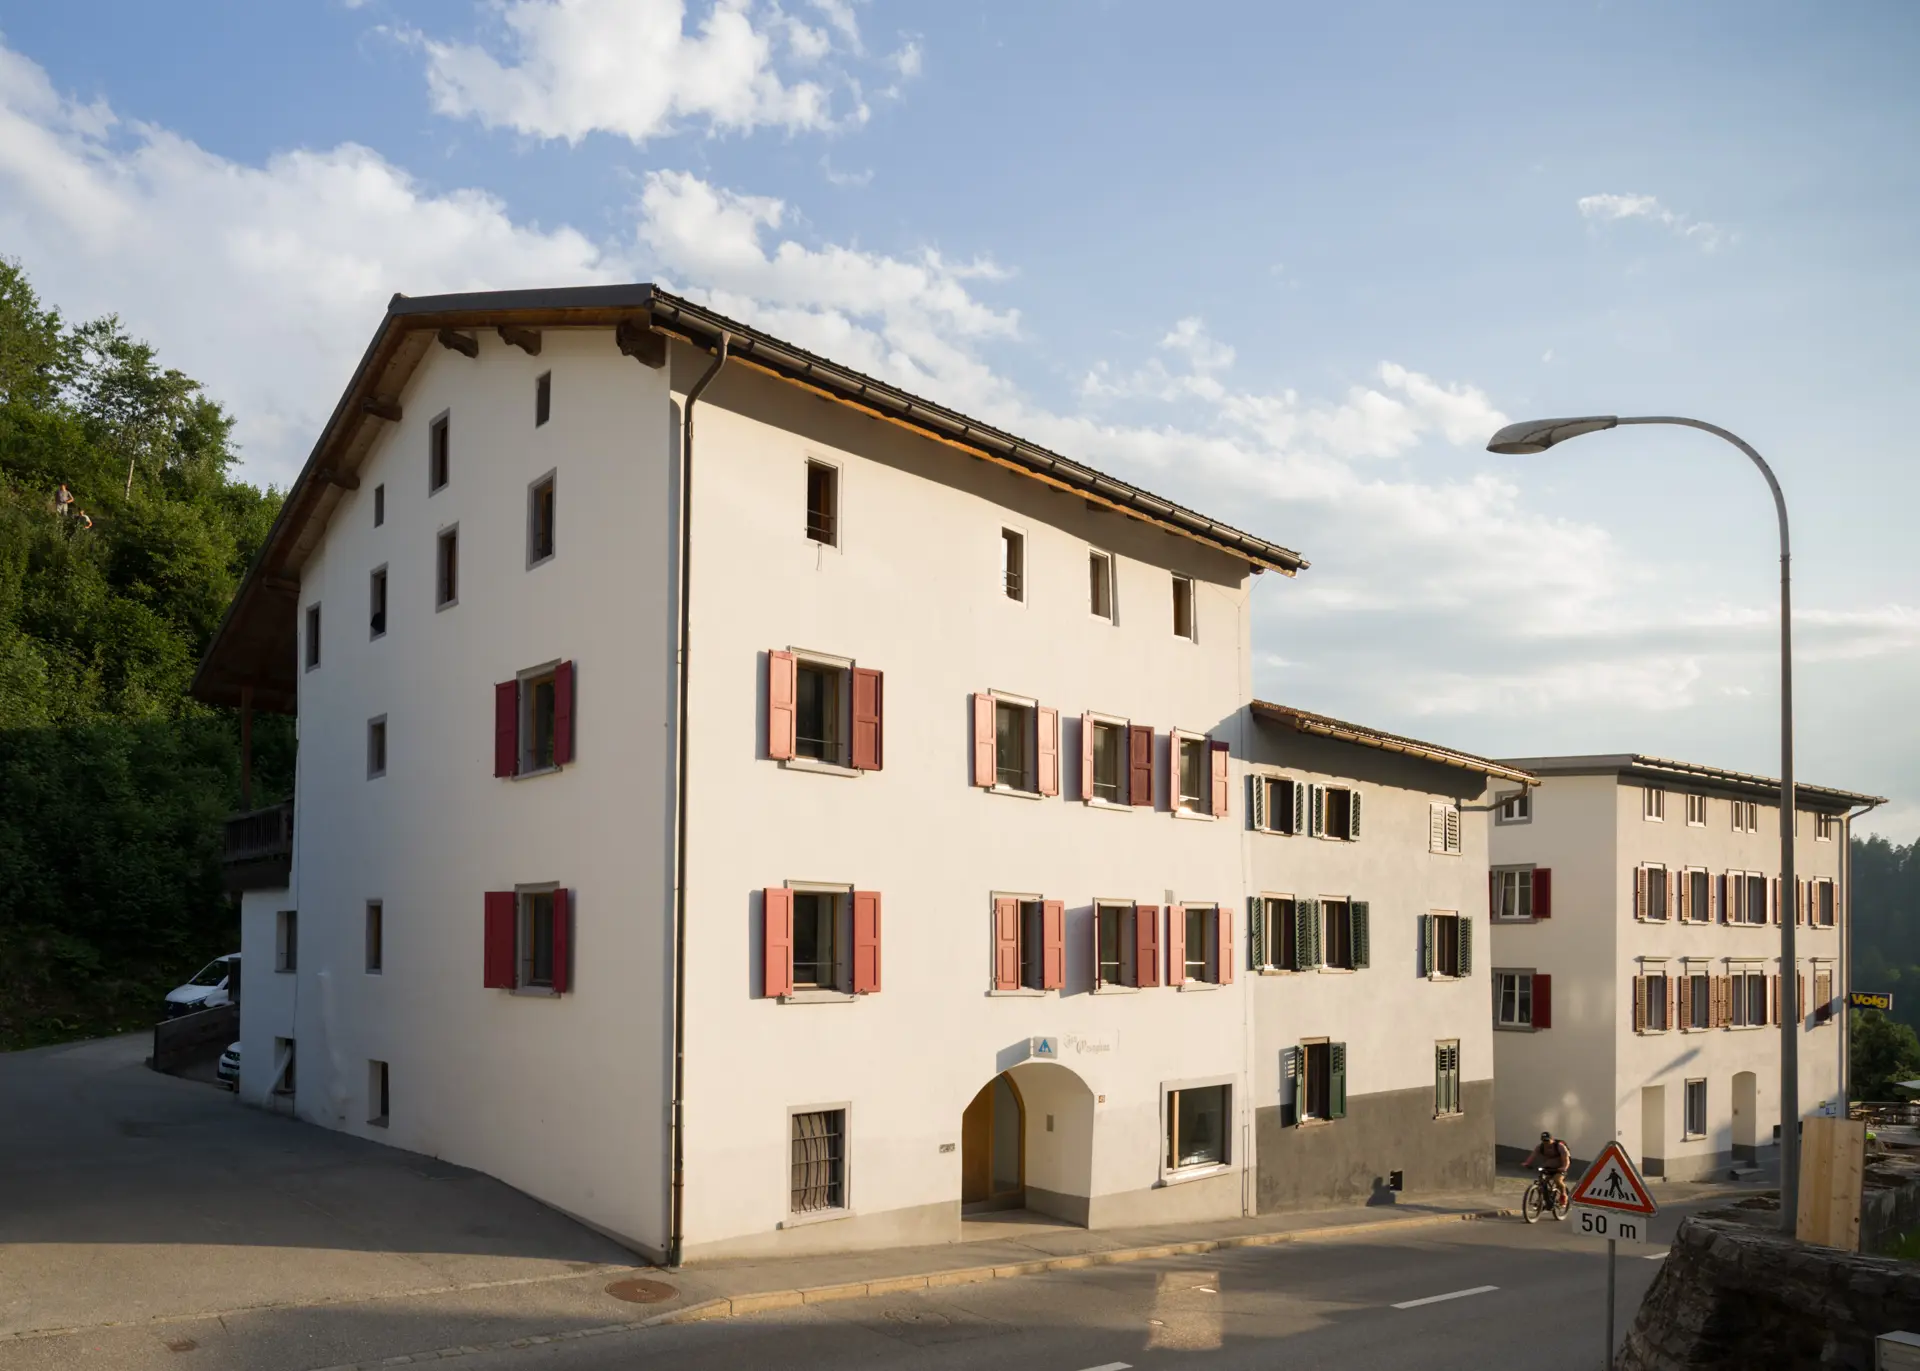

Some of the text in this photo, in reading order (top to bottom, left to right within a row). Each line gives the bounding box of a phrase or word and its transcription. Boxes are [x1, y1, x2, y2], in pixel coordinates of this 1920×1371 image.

[1852, 994, 1888, 1009] Volg
[1581, 1212, 1636, 1239] 50 m
